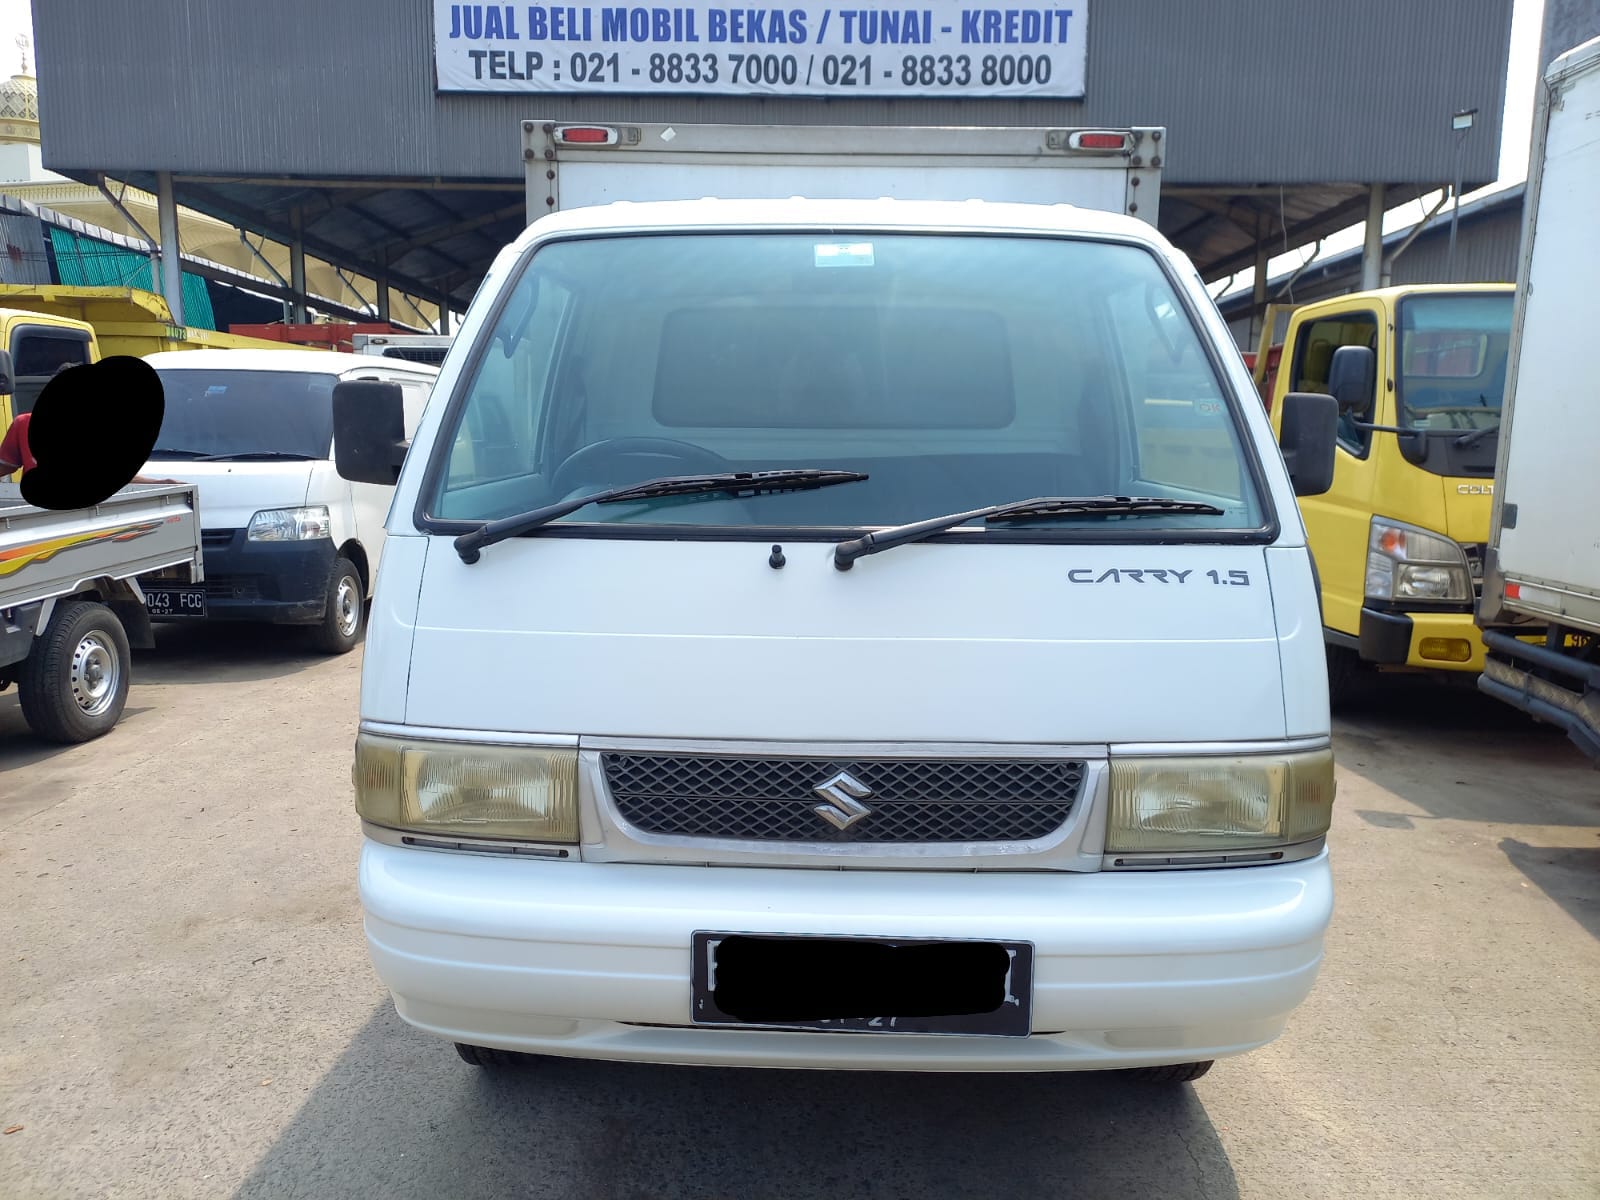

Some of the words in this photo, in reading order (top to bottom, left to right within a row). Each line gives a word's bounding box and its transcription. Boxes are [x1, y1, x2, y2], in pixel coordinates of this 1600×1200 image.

[449, 5, 519, 40] JUAL
[528, 6, 592, 41] BELI
[602, 7, 700, 43] MOBIL
[708, 8, 807, 44] BEKAS
[816, 9, 831, 44] /
[839, 10, 932, 44] TUNAI
[961, 10, 1073, 44] KREDIT
[468, 50, 544, 81] TELP
[570, 52, 620, 83] 021
[649, 53, 719, 84] 8833
[728, 53, 798, 85] 7000
[806, 54, 815, 85] /
[822, 54, 872, 86] 021
[902, 54, 972, 86] 8833
[981, 54, 1052, 85] 8000
[1067, 568, 1193, 583] CARRY
[1206, 569, 1250, 586] 1.5
